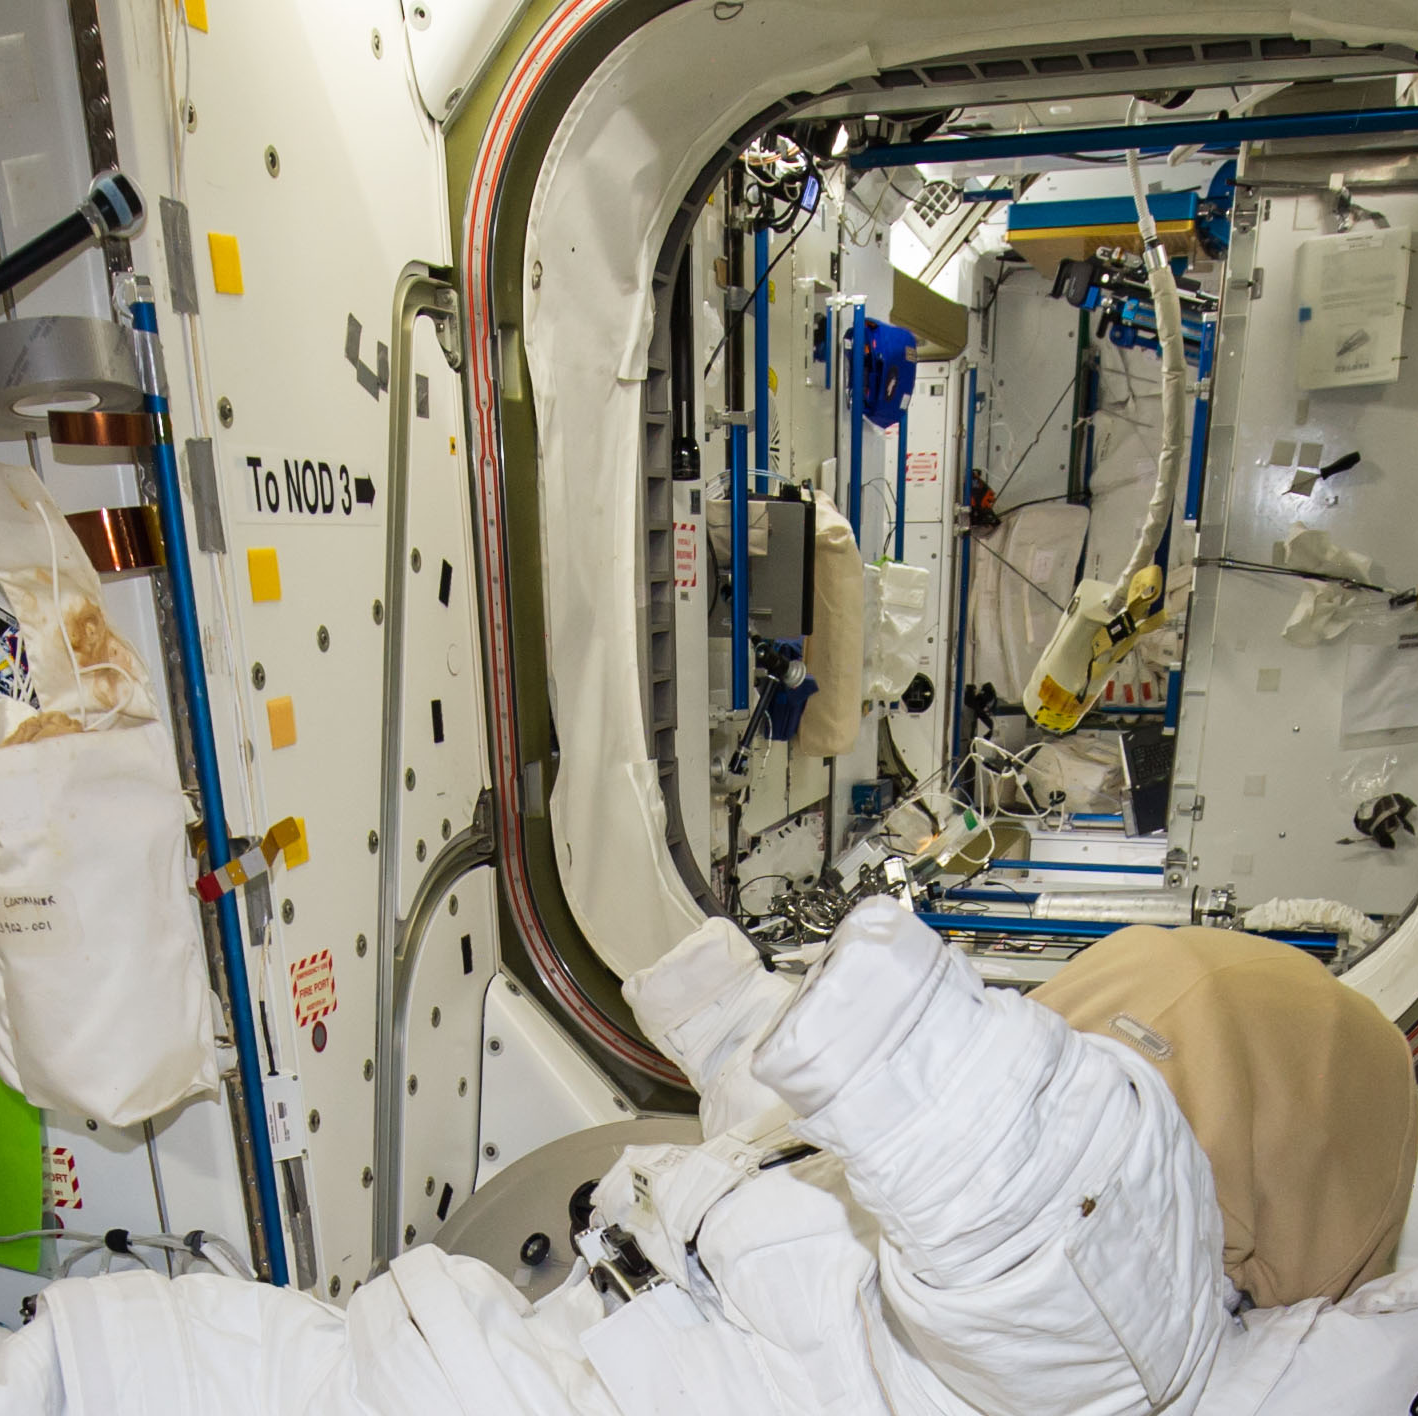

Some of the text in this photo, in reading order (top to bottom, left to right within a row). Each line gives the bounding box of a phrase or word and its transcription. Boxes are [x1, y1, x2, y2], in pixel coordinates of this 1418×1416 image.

[246, 455, 354, 517] To NOD 3
[299, 977, 330, 998] FIRE PORT
